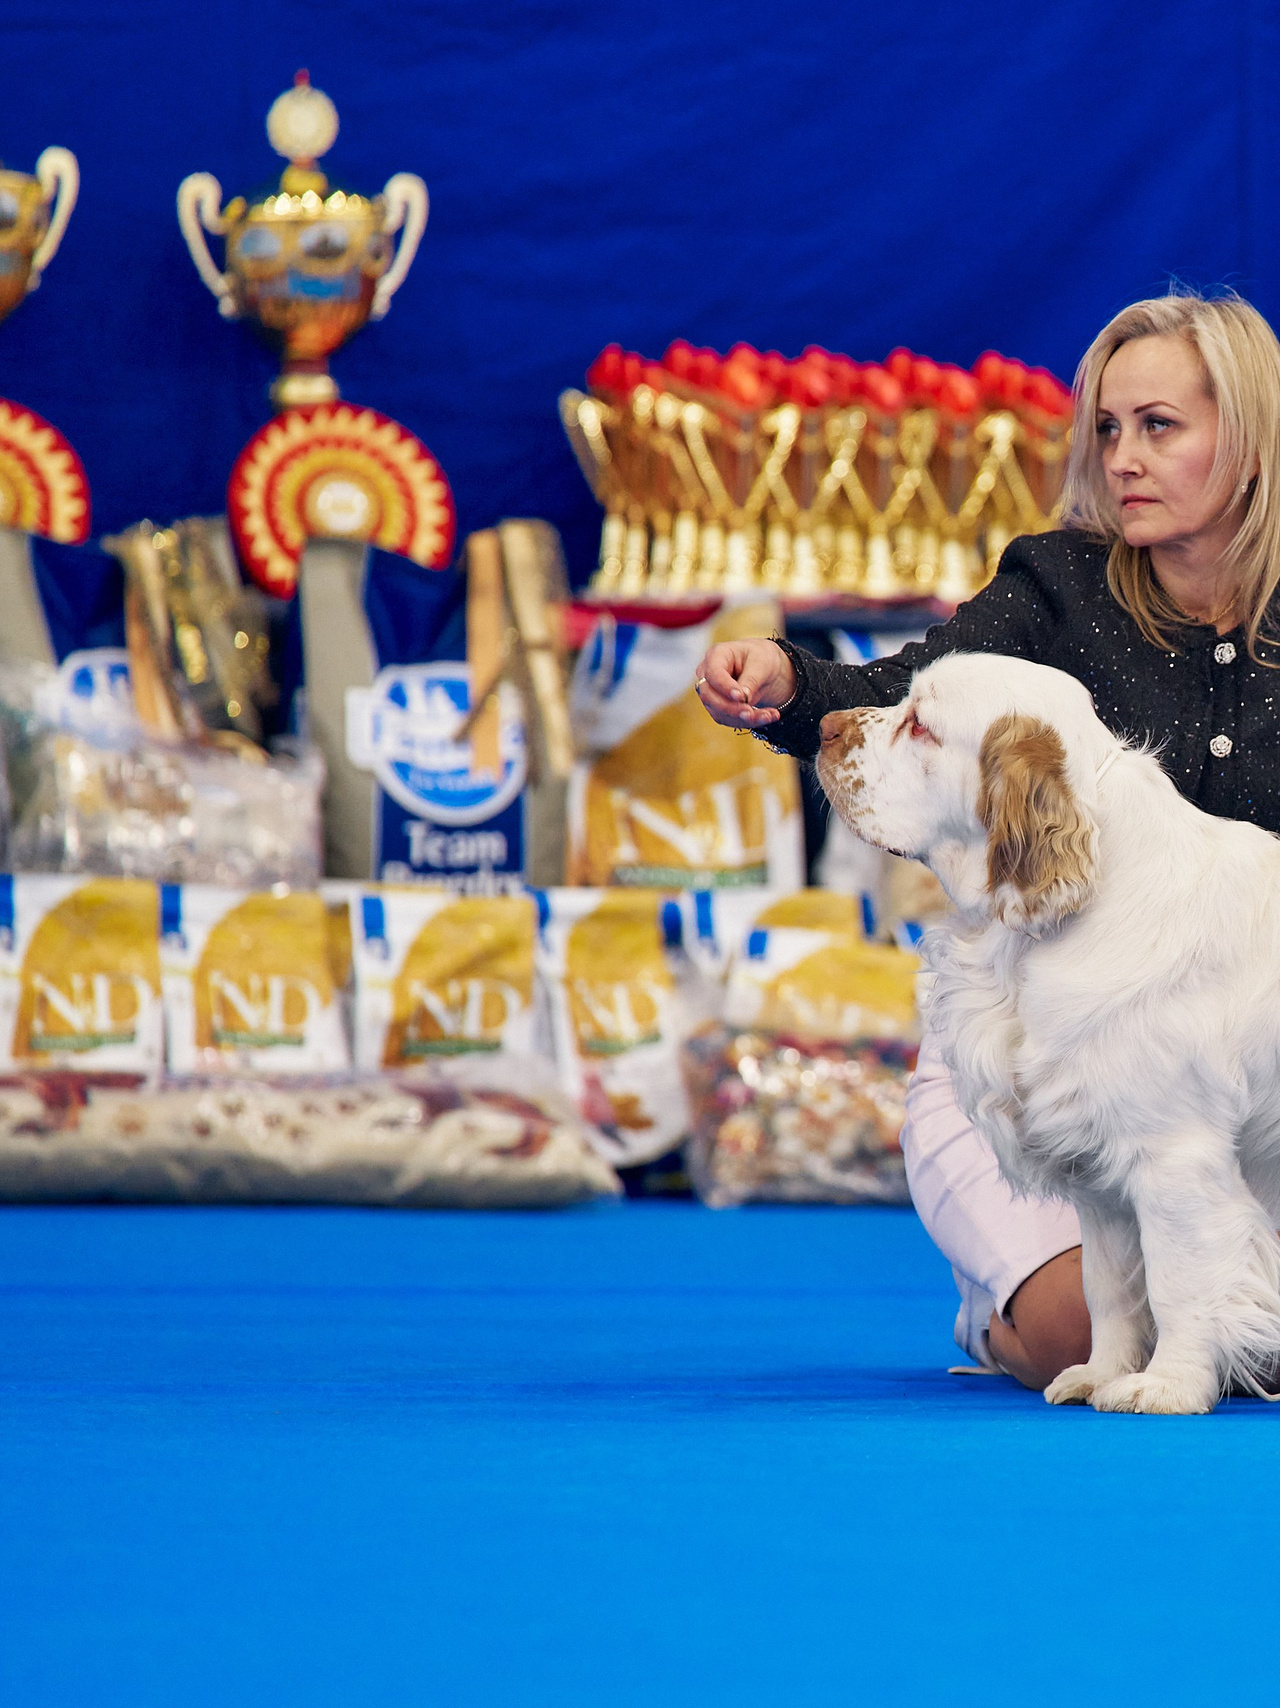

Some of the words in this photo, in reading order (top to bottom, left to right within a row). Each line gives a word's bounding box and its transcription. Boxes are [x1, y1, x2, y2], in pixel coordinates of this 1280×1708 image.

[402, 820, 508, 868] Team
[31, 972, 150, 1035] ND
[207, 969, 321, 1035] ND
[405, 977, 523, 1041] ND
